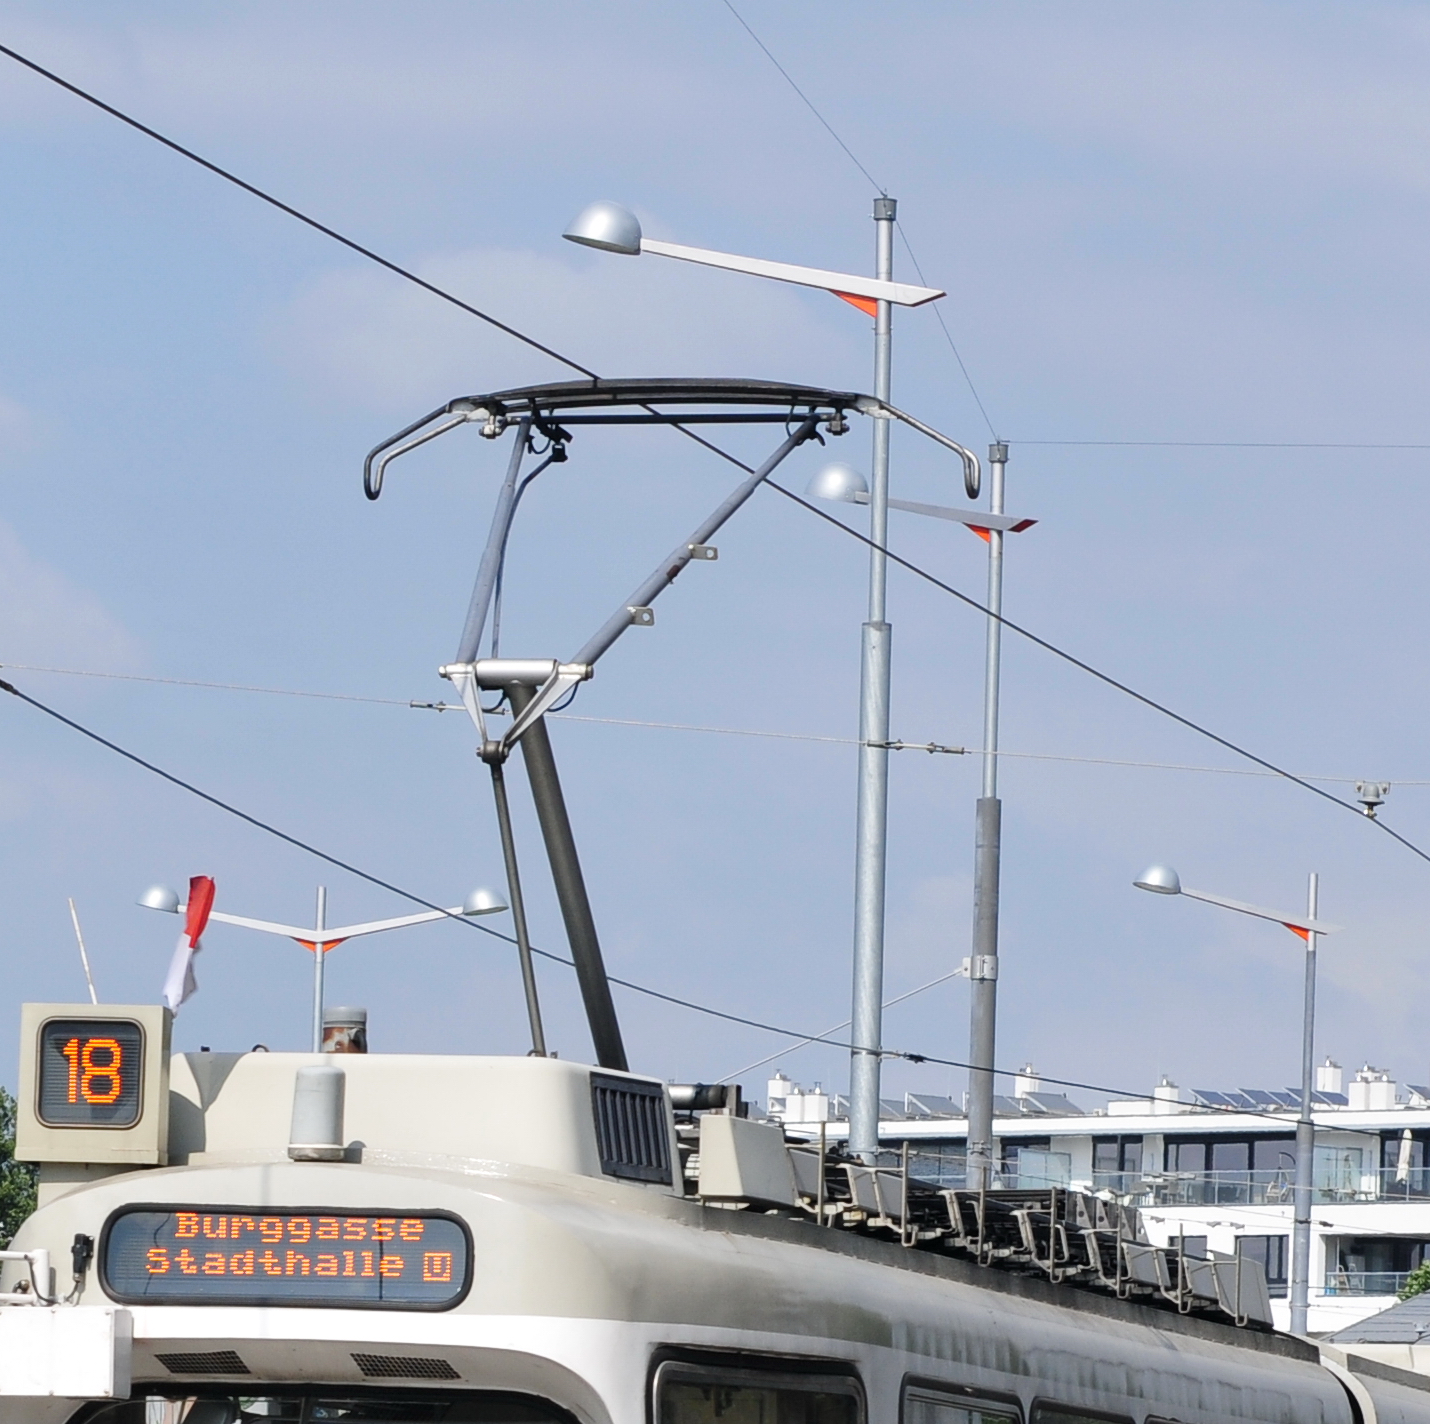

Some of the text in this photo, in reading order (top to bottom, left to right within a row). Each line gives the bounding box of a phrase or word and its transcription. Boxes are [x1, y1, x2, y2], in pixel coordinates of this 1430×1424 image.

[63, 1038, 122, 1104] 18
[174, 1212, 425, 1244] Burggasse
[145, 1248, 405, 1278] Stadthalle
